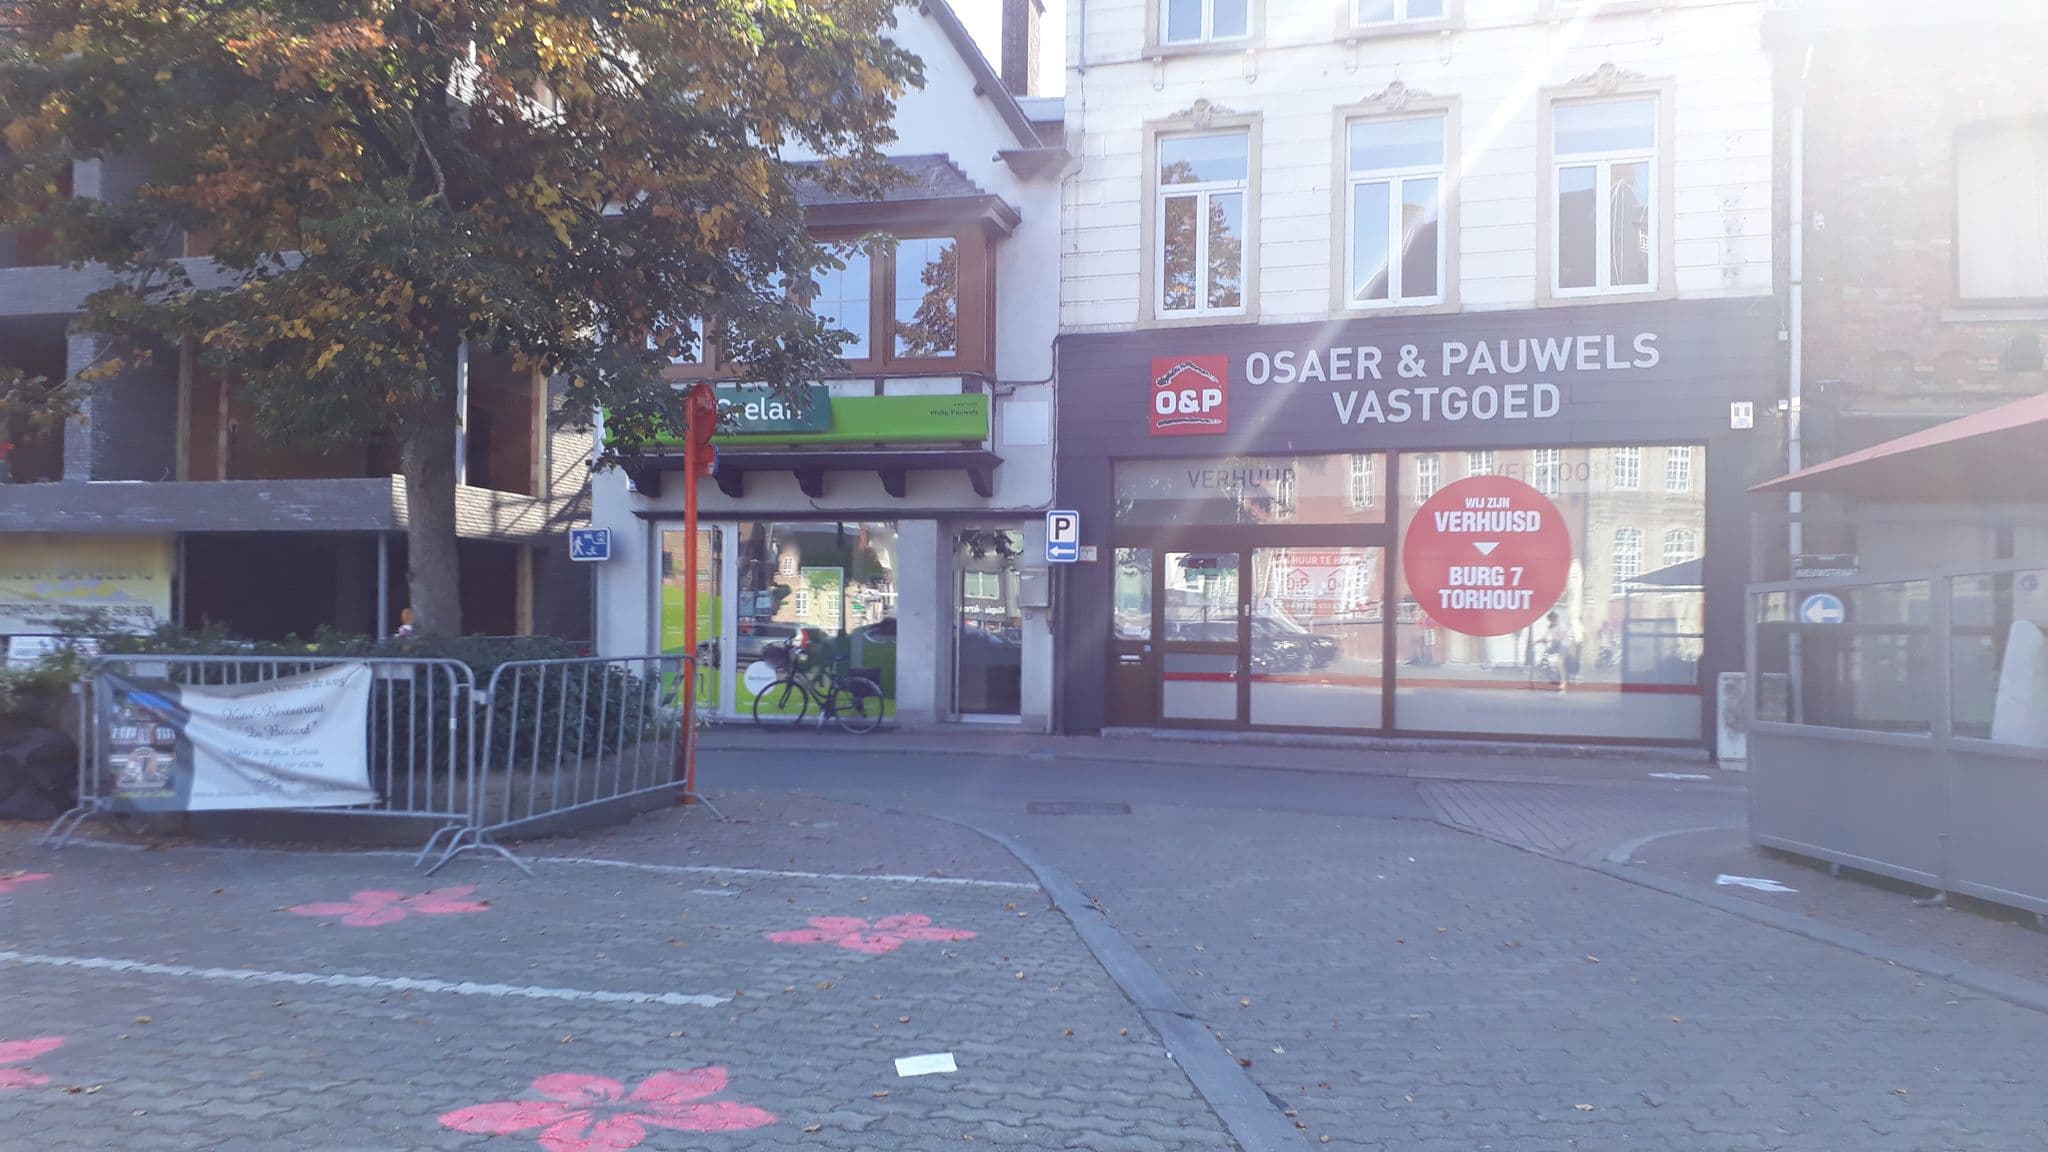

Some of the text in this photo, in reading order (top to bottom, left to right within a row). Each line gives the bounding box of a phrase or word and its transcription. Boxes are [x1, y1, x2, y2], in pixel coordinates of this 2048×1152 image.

[1245, 332, 1661, 385] OSAER & PAUWELS
[1155, 388, 1223, 415] O&P
[1332, 383, 1561, 425] VASTGOED
[1465, 497, 1510, 508] WIJ ZIJN
[1055, 517, 1071, 540] P
[1434, 510, 1541, 532] VERHUISD
[1448, 566, 1524, 586] BURG 7
[1438, 588, 1534, 610] TORHOUT
